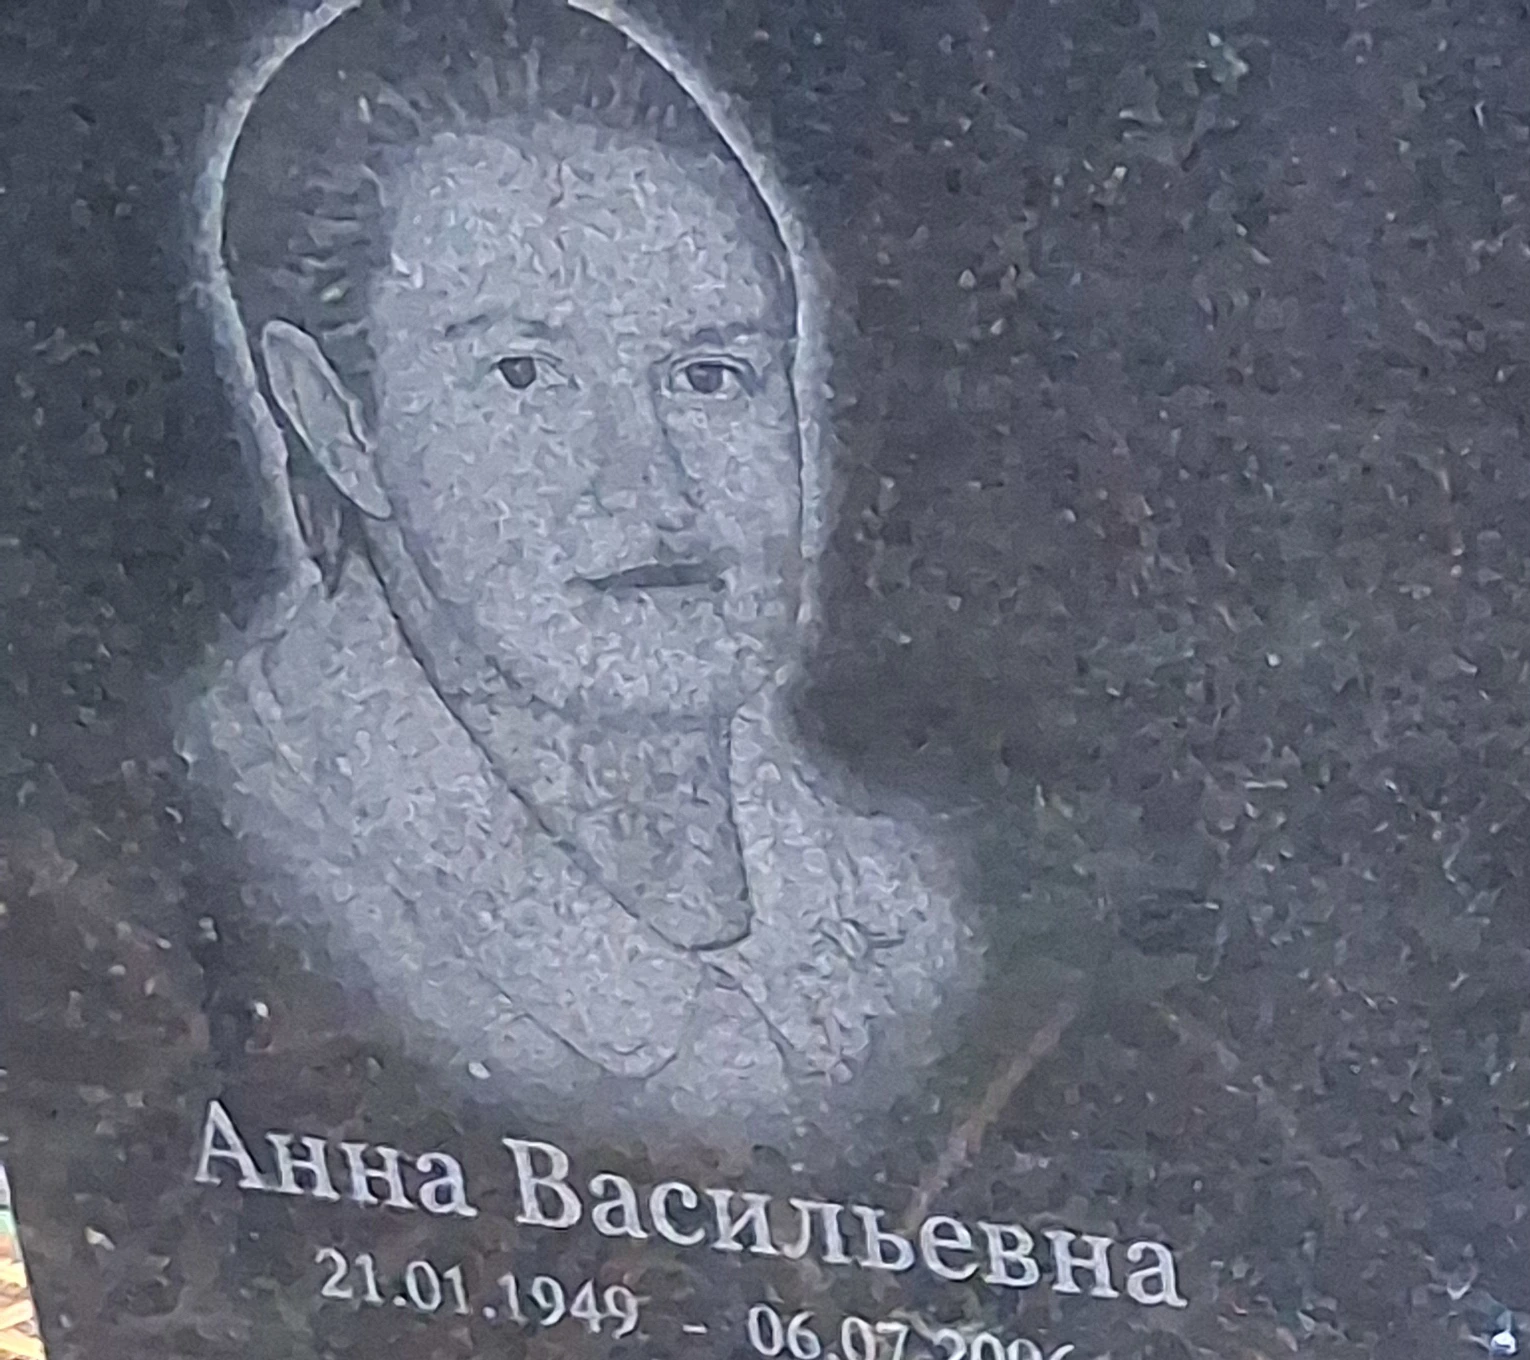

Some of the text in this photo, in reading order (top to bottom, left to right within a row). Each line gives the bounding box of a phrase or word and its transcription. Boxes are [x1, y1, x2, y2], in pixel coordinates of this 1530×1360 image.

[195, 1098, 1188, 1308] Анна Васильевна
[314, 1247, 641, 1340] 21.01.1949
